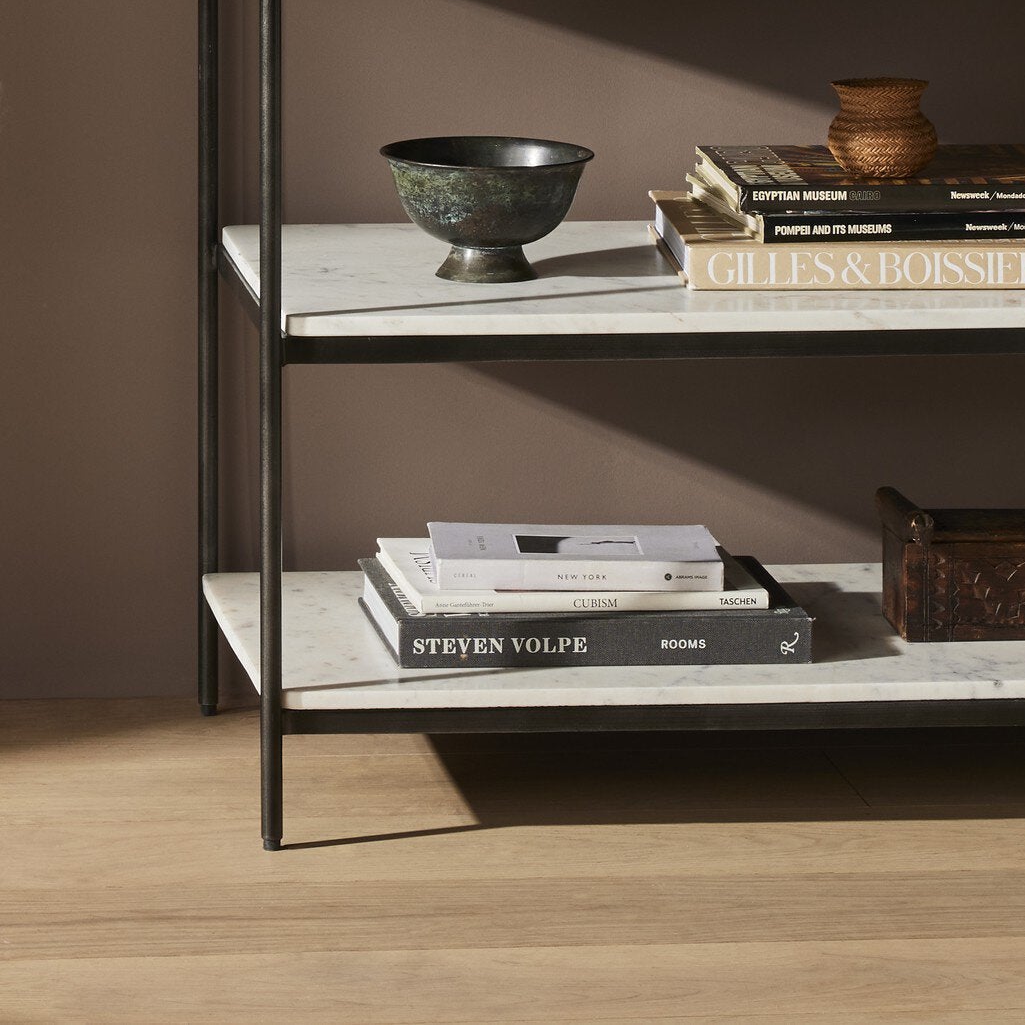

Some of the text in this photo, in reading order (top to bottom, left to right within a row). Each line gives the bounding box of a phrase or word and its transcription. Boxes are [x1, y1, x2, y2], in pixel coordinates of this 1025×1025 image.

[752, 190, 881, 201] EGYPTIAN MUSEUM CAIRO
[774, 224, 892, 236] POMPEII AND ITS MUSEUMS
[707, 251, 834, 285] GILLES
[841, 251, 872, 285] &
[573, 598, 618, 609] CUBISM
[719, 597, 757, 606] TASCHEN
[412, 637, 588, 655] STEVEN VOLPE
[661, 639, 707, 650] ROOMS
